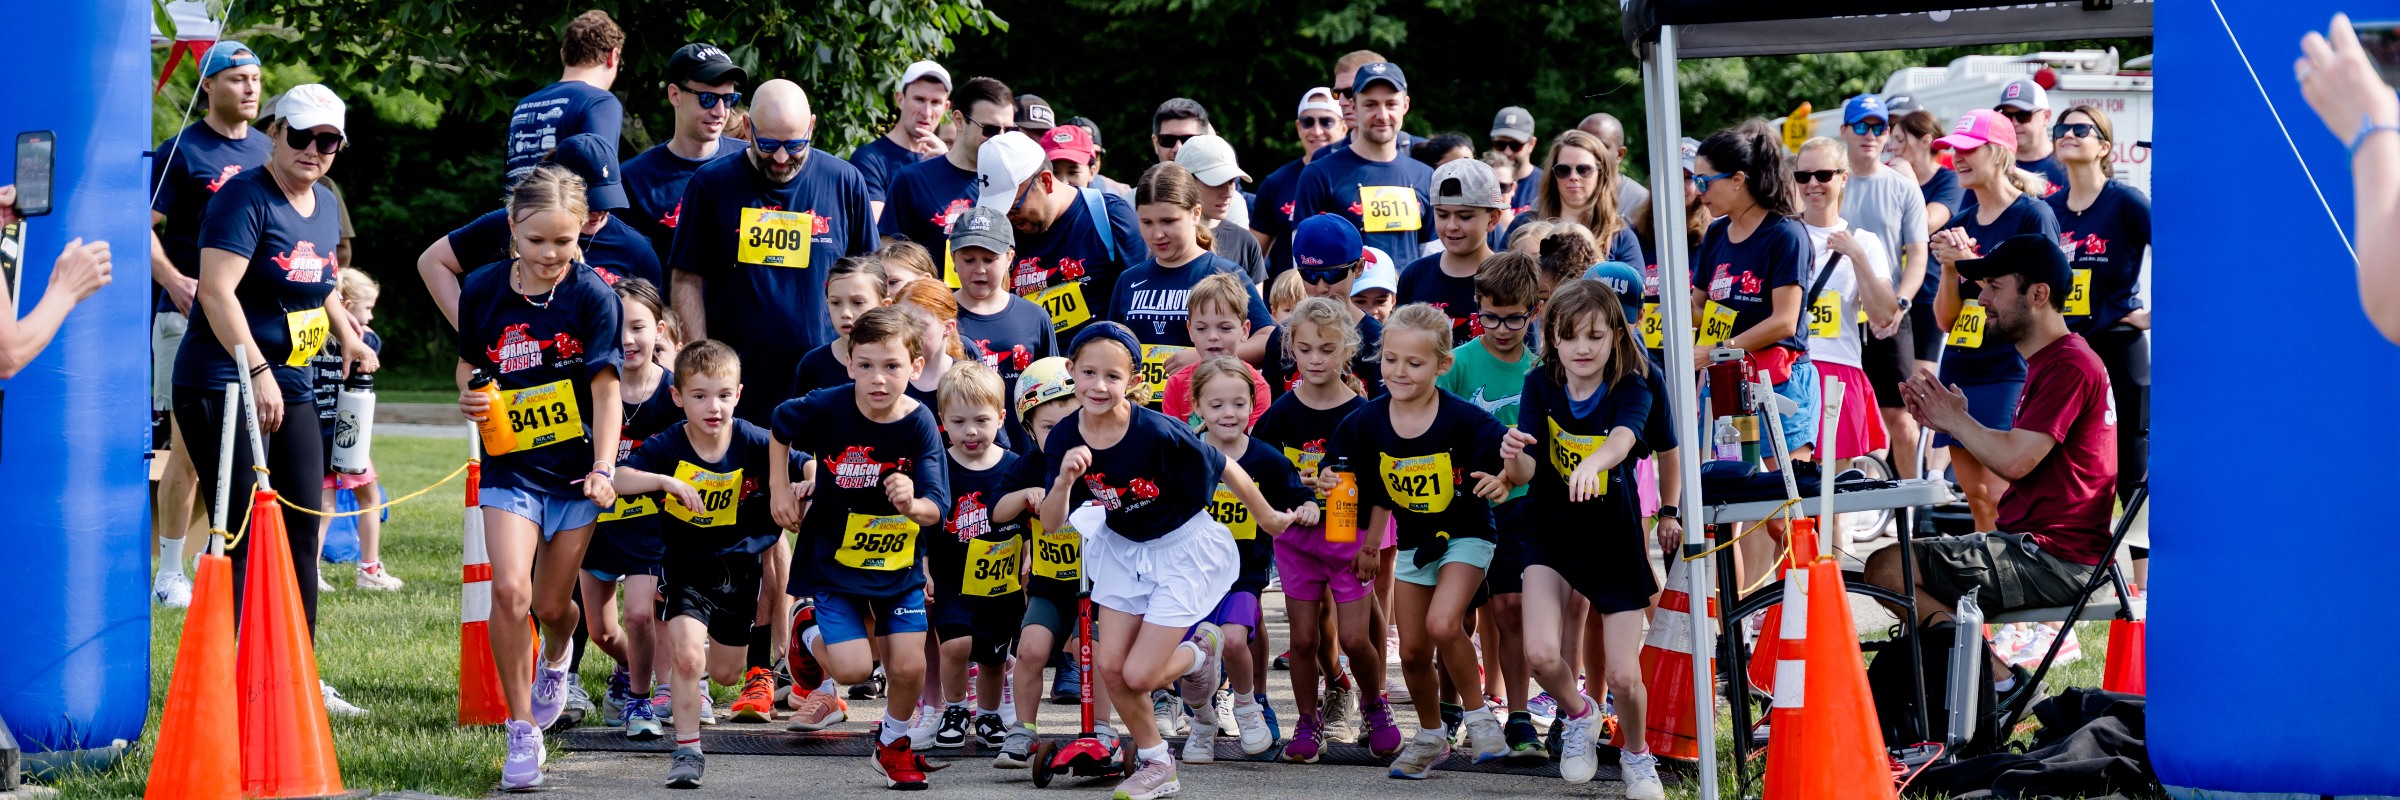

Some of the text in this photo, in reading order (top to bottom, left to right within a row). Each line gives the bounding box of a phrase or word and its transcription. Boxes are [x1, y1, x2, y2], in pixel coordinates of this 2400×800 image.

[2106, 98, 2125, 113] FOR
[2112, 142, 2148, 164] SLO
[1370, 200, 1409, 218] 3511
[748, 226, 801, 251] 3409
[1014, 269, 1048, 287] DRAGON
[1041, 292, 1077, 318] 470
[1131, 289, 1191, 311] VILLANOV
[1810, 305, 1832, 324] 35
[298, 326, 325, 352] 3481
[499, 340, 540, 360] DRAGON
[499, 355, 530, 374] DASH
[530, 352, 543, 368] 5K
[526, 391, 558, 405] RACING CO
[508, 401, 569, 433] 3413
[535, 434, 555, 442] NOLAN
[1565, 440, 1583, 451] RACING
[1553, 438, 1583, 473] 353
[836, 463, 881, 477] DRAGON
[1405, 464, 1426, 472] RACING
[704, 479, 725, 487] RACING
[835, 475, 879, 489] DASH 5K
[1388, 473, 1440, 497] 3421
[956, 507, 988, 529] DRAGO
[1209, 501, 1248, 524] 435
[849, 532, 909, 554] 3598
[1052, 533, 1074, 541] RACING
[974, 552, 1015, 580] 3479
